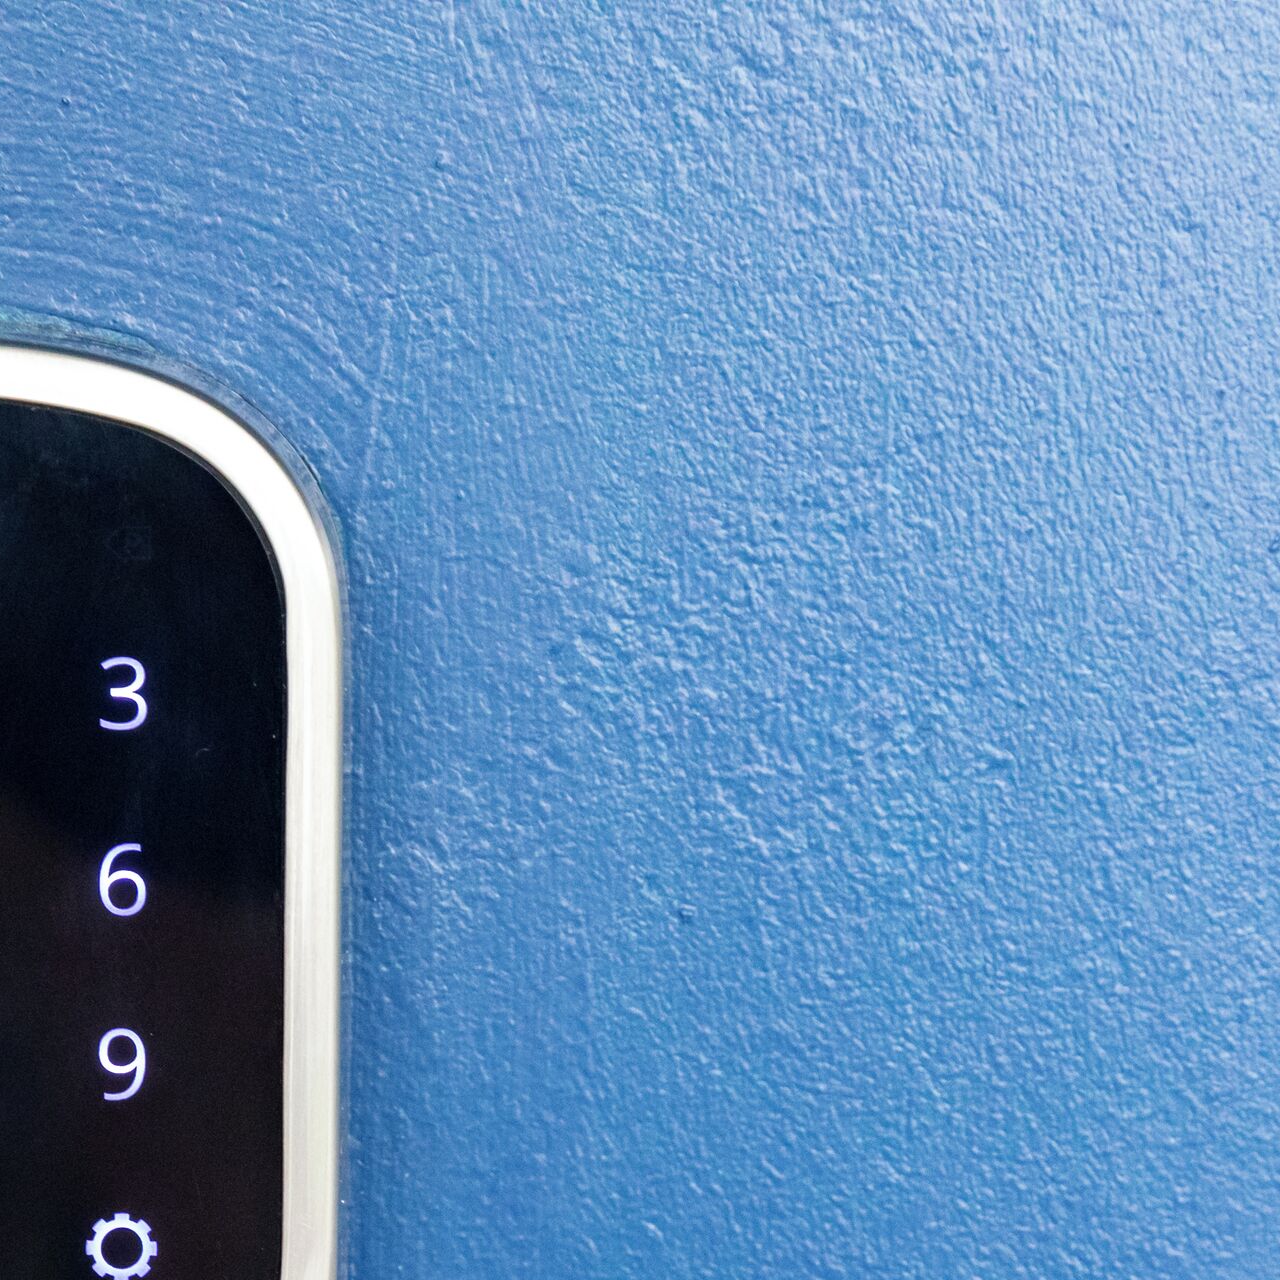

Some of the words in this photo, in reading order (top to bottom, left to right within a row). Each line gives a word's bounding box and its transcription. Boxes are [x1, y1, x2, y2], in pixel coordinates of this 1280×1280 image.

[99, 656, 149, 731] 3
[99, 843, 147, 917] 6
[98, 1028, 146, 1101] 9
